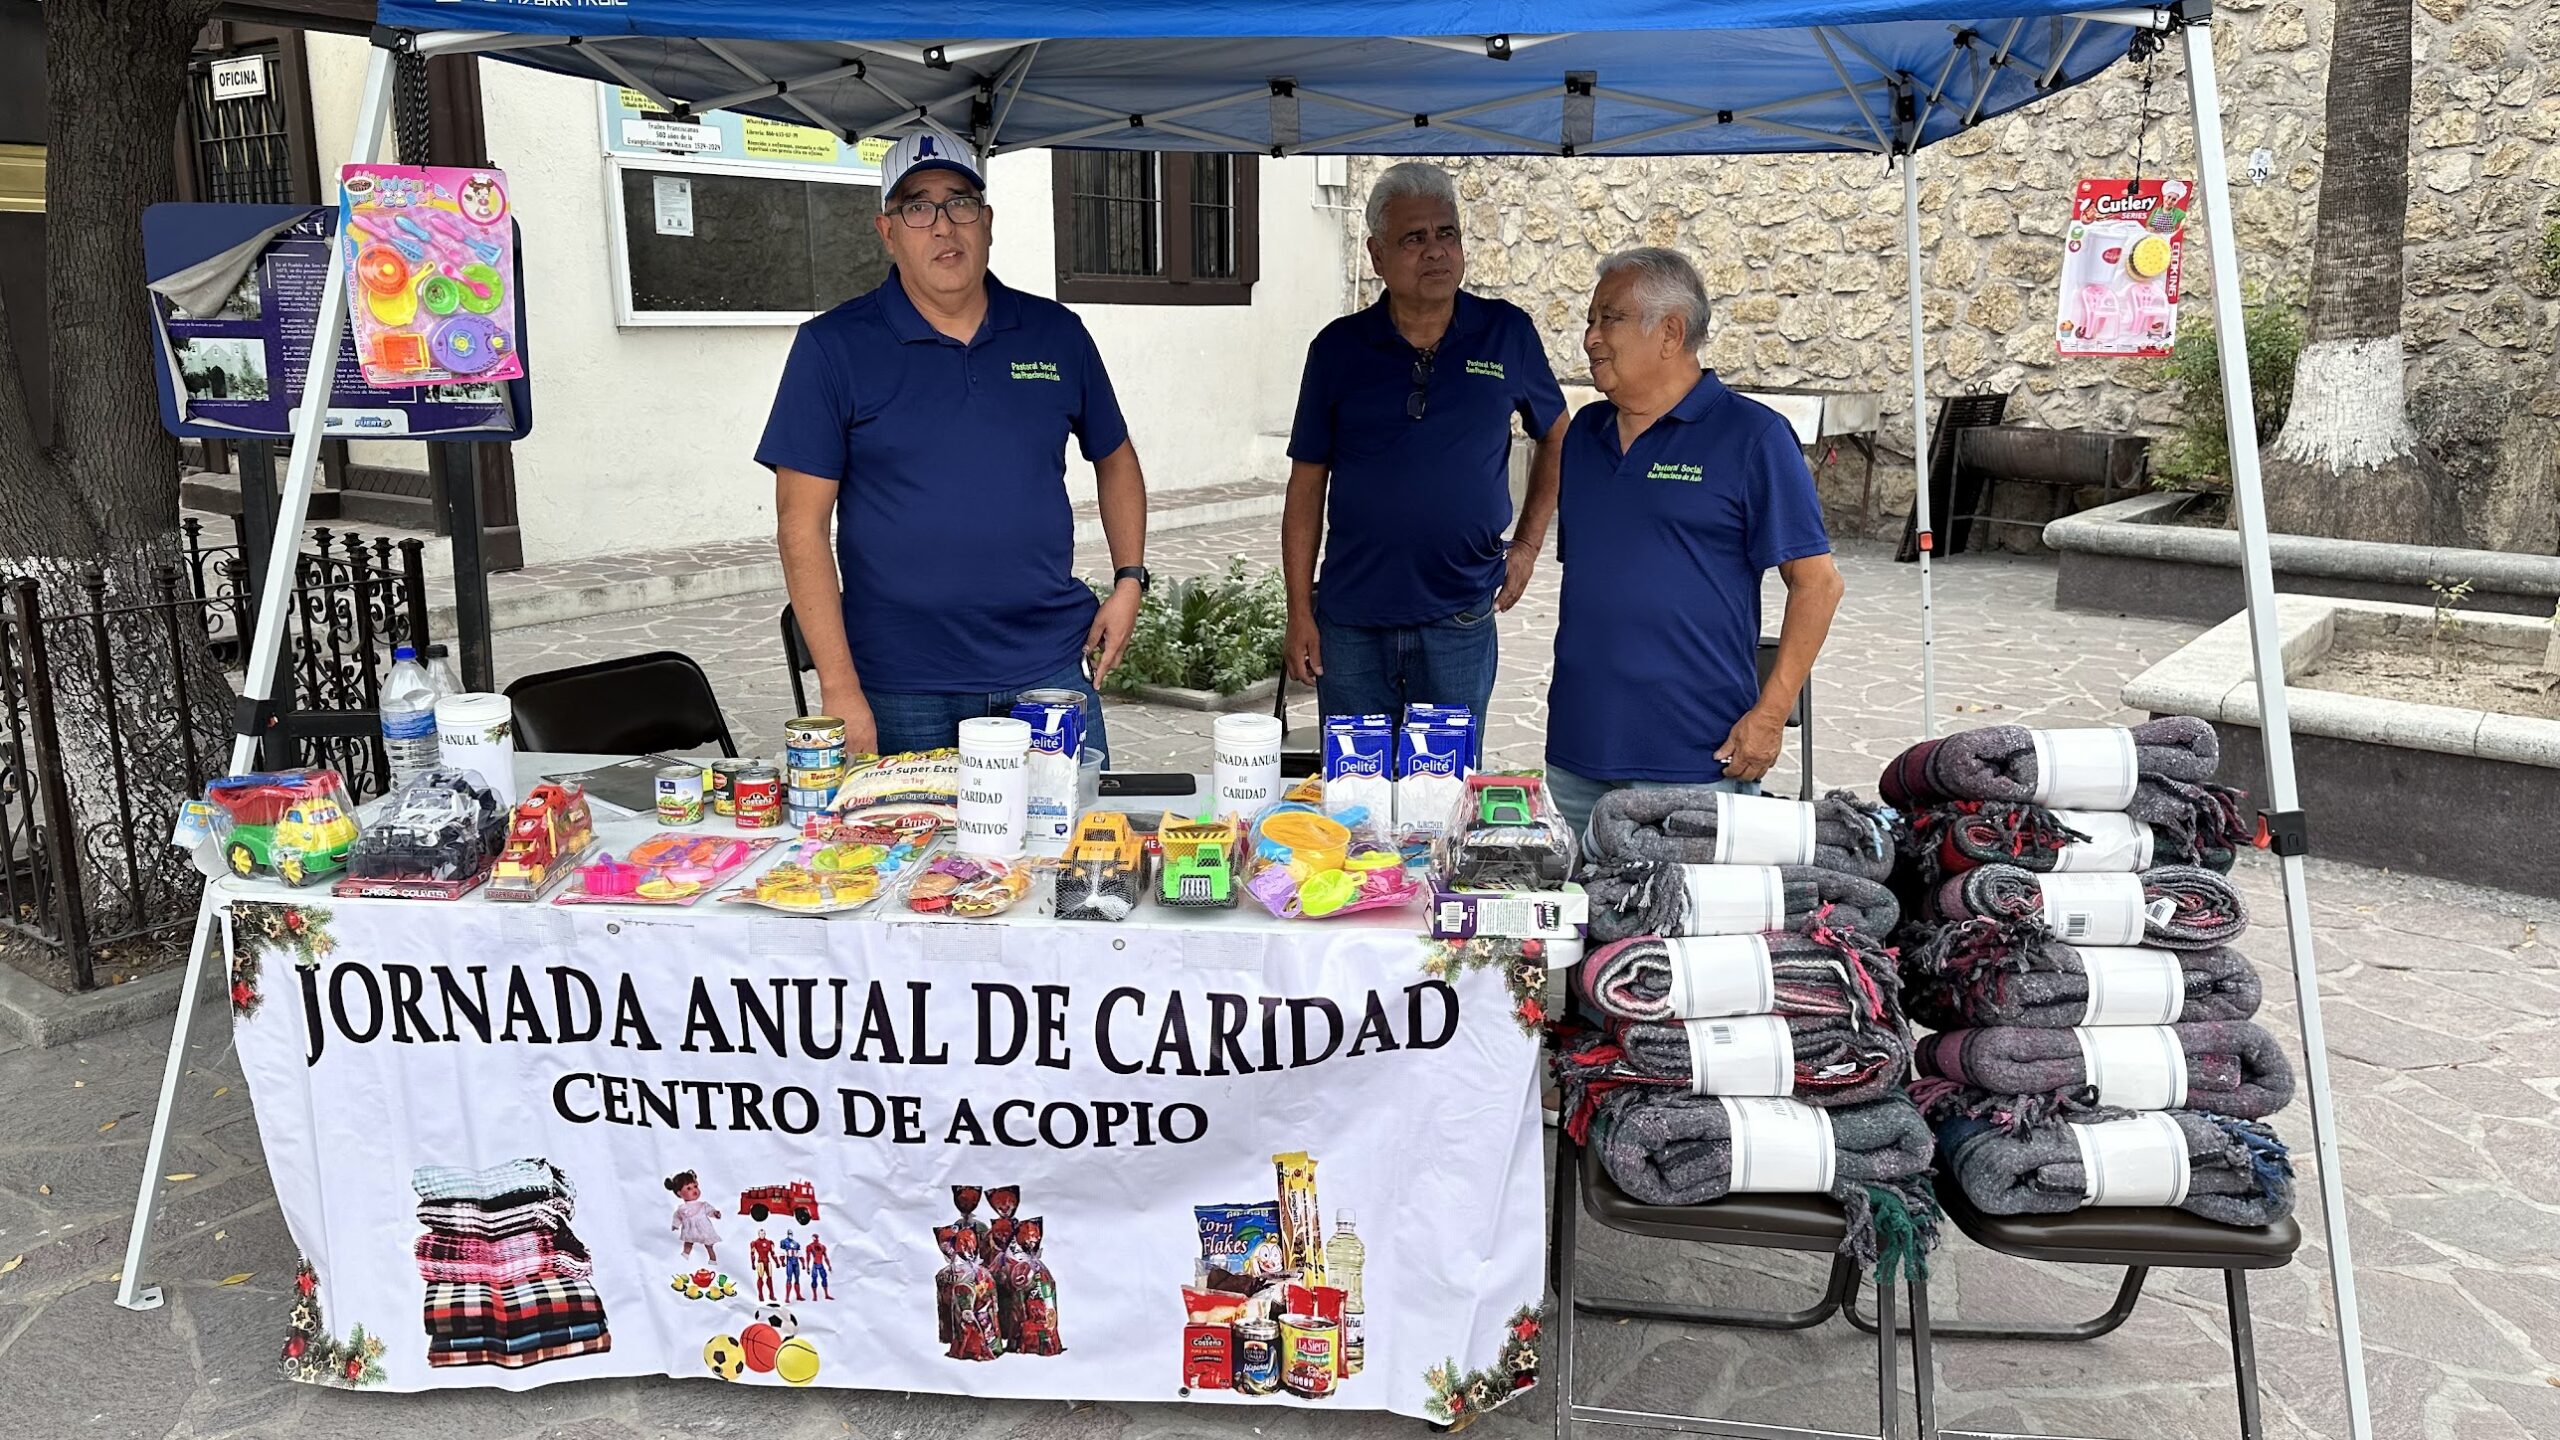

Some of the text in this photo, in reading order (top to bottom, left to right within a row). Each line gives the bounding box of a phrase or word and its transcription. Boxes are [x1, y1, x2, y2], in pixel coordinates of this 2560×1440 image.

[219, 70, 257, 87] OFICINA
[2097, 194, 2158, 214] Cutlery
[2121, 211, 2148, 220] SERIES
[2166, 241, 2181, 297] COOKING
[1652, 462, 1704, 475] Pastoral Social
[1030, 735, 1059, 749] elité
[986, 757, 1020, 770] ANUAL
[1251, 752, 1279, 767] ANUAL
[1340, 760, 1377, 773] Delité
[1412, 759, 1449, 772] Delité
[862, 769, 892, 779] Arroz
[1239, 775, 1248, 783] DE
[973, 777, 982, 786] DE
[960, 788, 1003, 804] CARIDAD
[1222, 786, 1267, 800] CARIDAD
[362, 889, 450, 899] CROSS COUNTRY
[294, 963, 1461, 1077] JORNADA ANUAL DE CARIDAD
[552, 1072, 1209, 1150] CENTRO DE ACOPIO
[1198, 1217, 1232, 1233] Corn
[1203, 1234, 1248, 1256] Flakes
[1298, 1339, 1329, 1352] La Sierra
